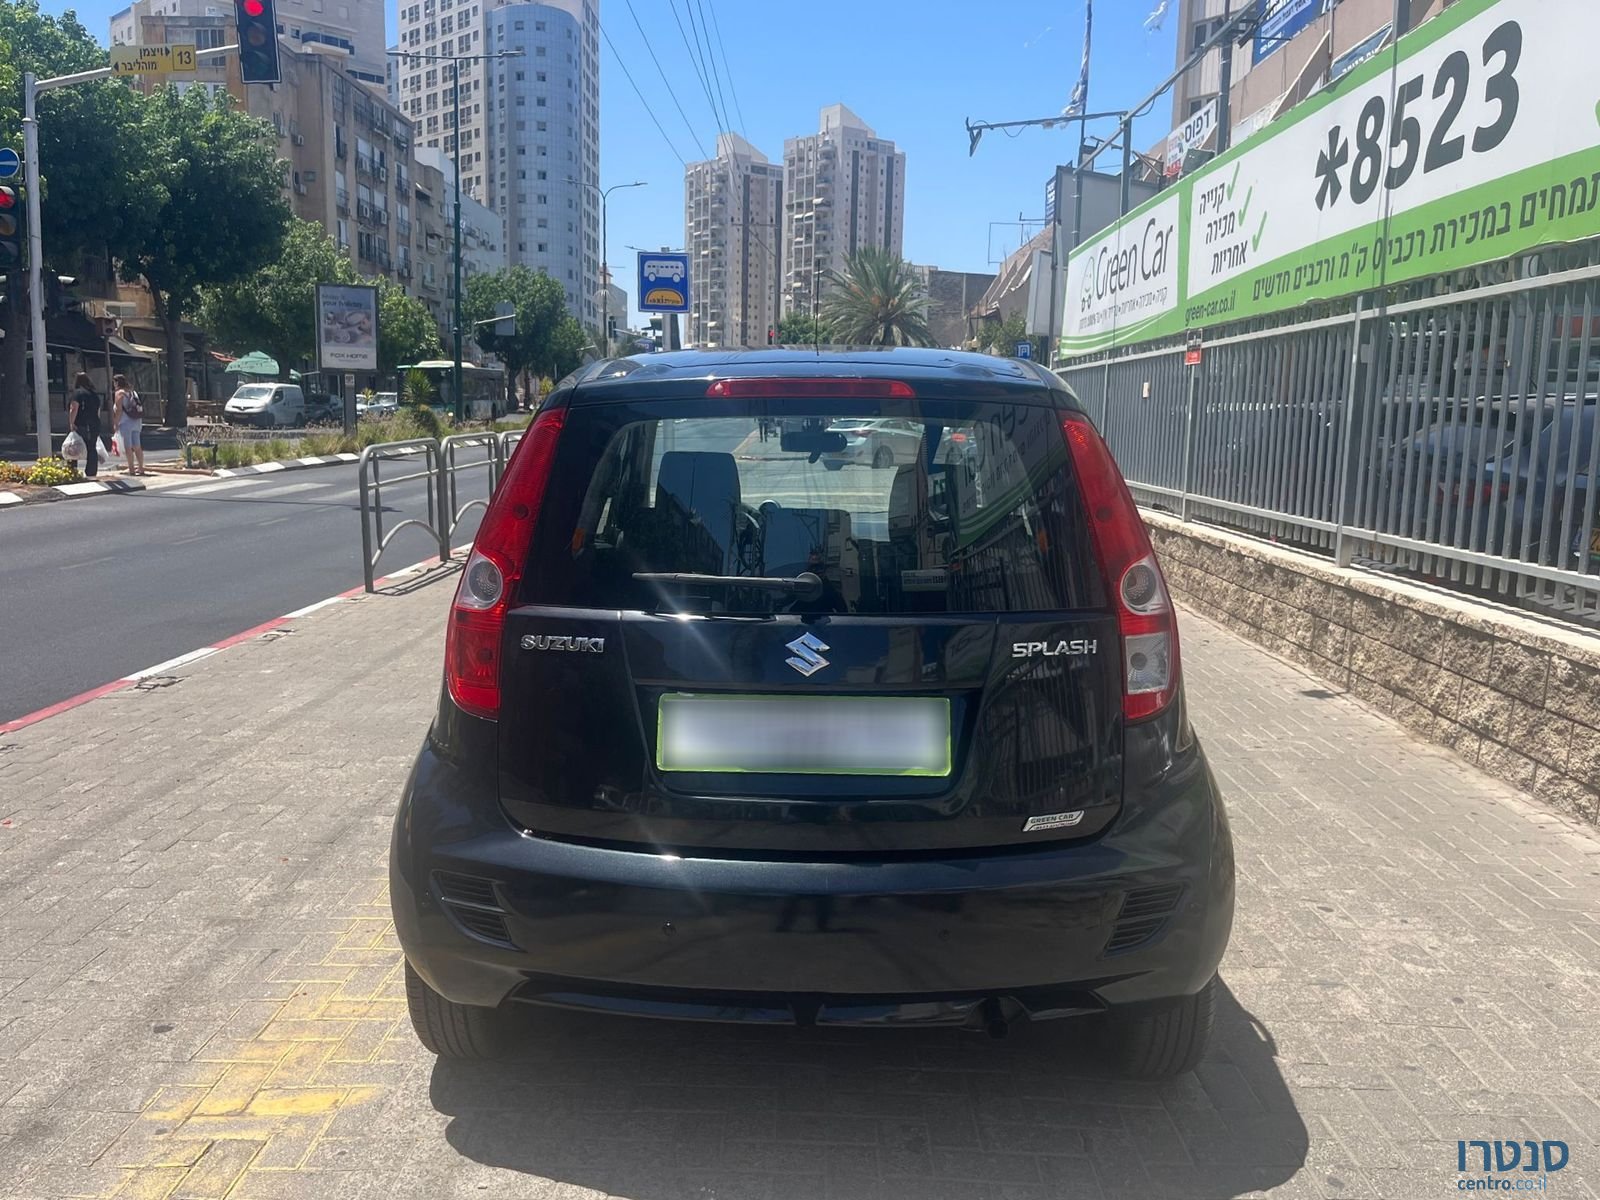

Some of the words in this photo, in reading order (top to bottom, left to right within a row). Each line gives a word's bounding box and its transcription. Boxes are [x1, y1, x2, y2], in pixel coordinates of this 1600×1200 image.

[121, 59, 157, 71] מוהליבר
[140, 47, 163, 59] ויצמן
[177, 51, 192, 65] 13
[1185, 108, 1211, 143] דפוס
[1199, 182, 1226, 215] קנייה
[1205, 210, 1236, 245] מכירה
[1429, 200, 1511, 255] במכירת
[1096, 244, 1138, 300] Green
[1141, 218, 1174, 281] Car
[1211, 240, 1248, 275] אחריות
[1389, 228, 1426, 266] רכבי
[1252, 269, 1291, 301] חדשים
[1293, 255, 1336, 290] ורכבים
[1185, 289, 1237, 327] green-car.co.il
[520, 634, 605, 653] SUZUKI
[1012, 639, 1097, 658] SPLASH
[1030, 816, 1057, 824] GREEN
[1058, 813, 1075, 821] CAR
